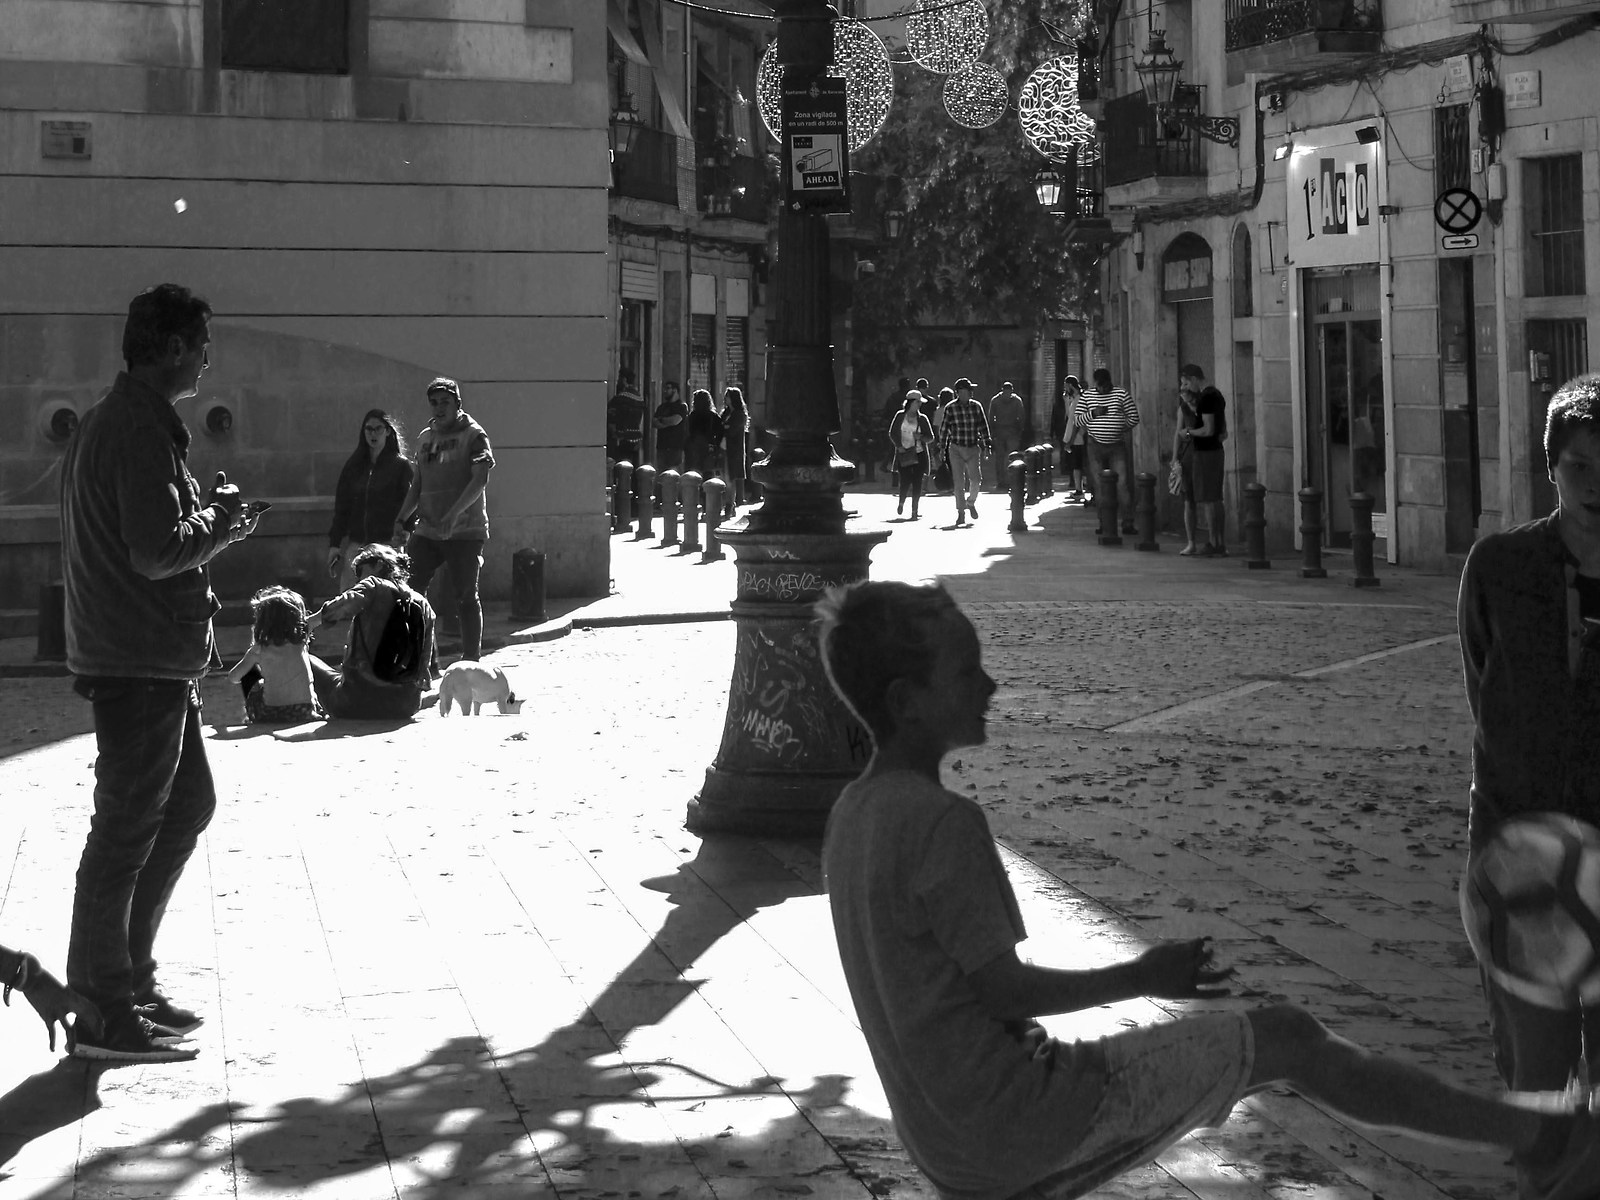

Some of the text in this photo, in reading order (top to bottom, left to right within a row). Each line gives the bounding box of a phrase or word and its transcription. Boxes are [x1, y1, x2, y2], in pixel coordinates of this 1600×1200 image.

[812, 111, 837, 120] vigilada
[806, 175, 836, 184] AHEAD.
[1320, 169, 1368, 228] ACTO
